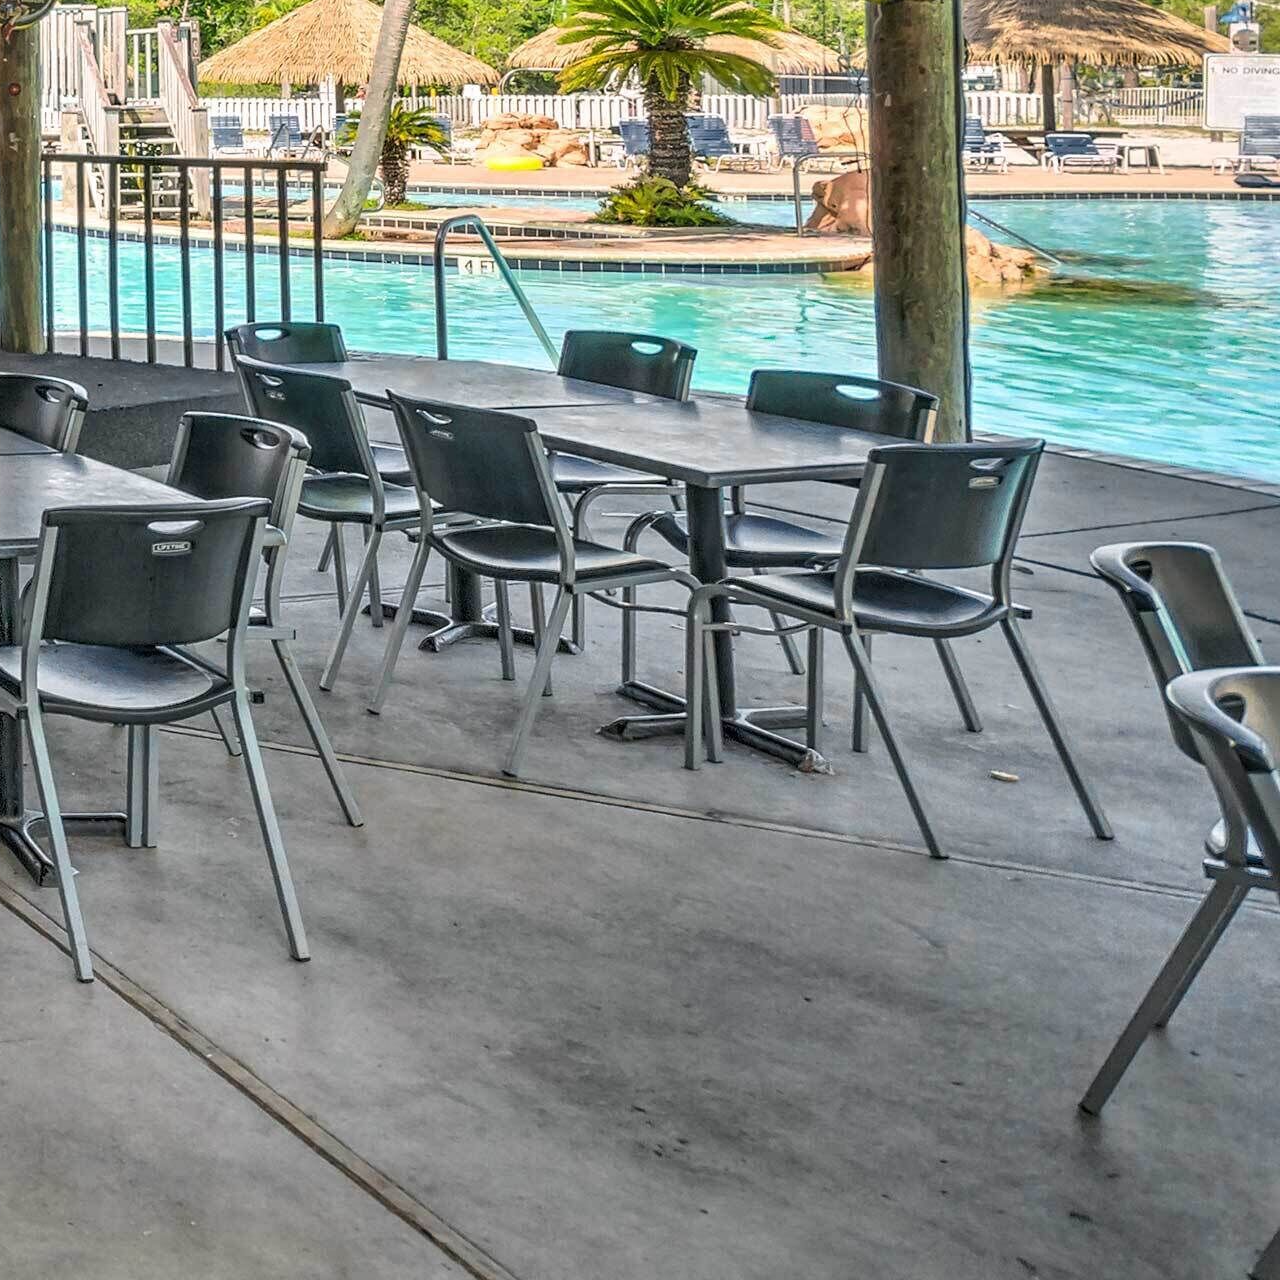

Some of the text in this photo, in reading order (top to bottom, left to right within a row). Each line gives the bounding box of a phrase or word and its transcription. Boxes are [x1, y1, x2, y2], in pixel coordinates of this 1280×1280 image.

[1222, 66, 1239, 75] NO
[1242, 66, 1280, 76] DIVING
[464, 260, 473, 274] 4
